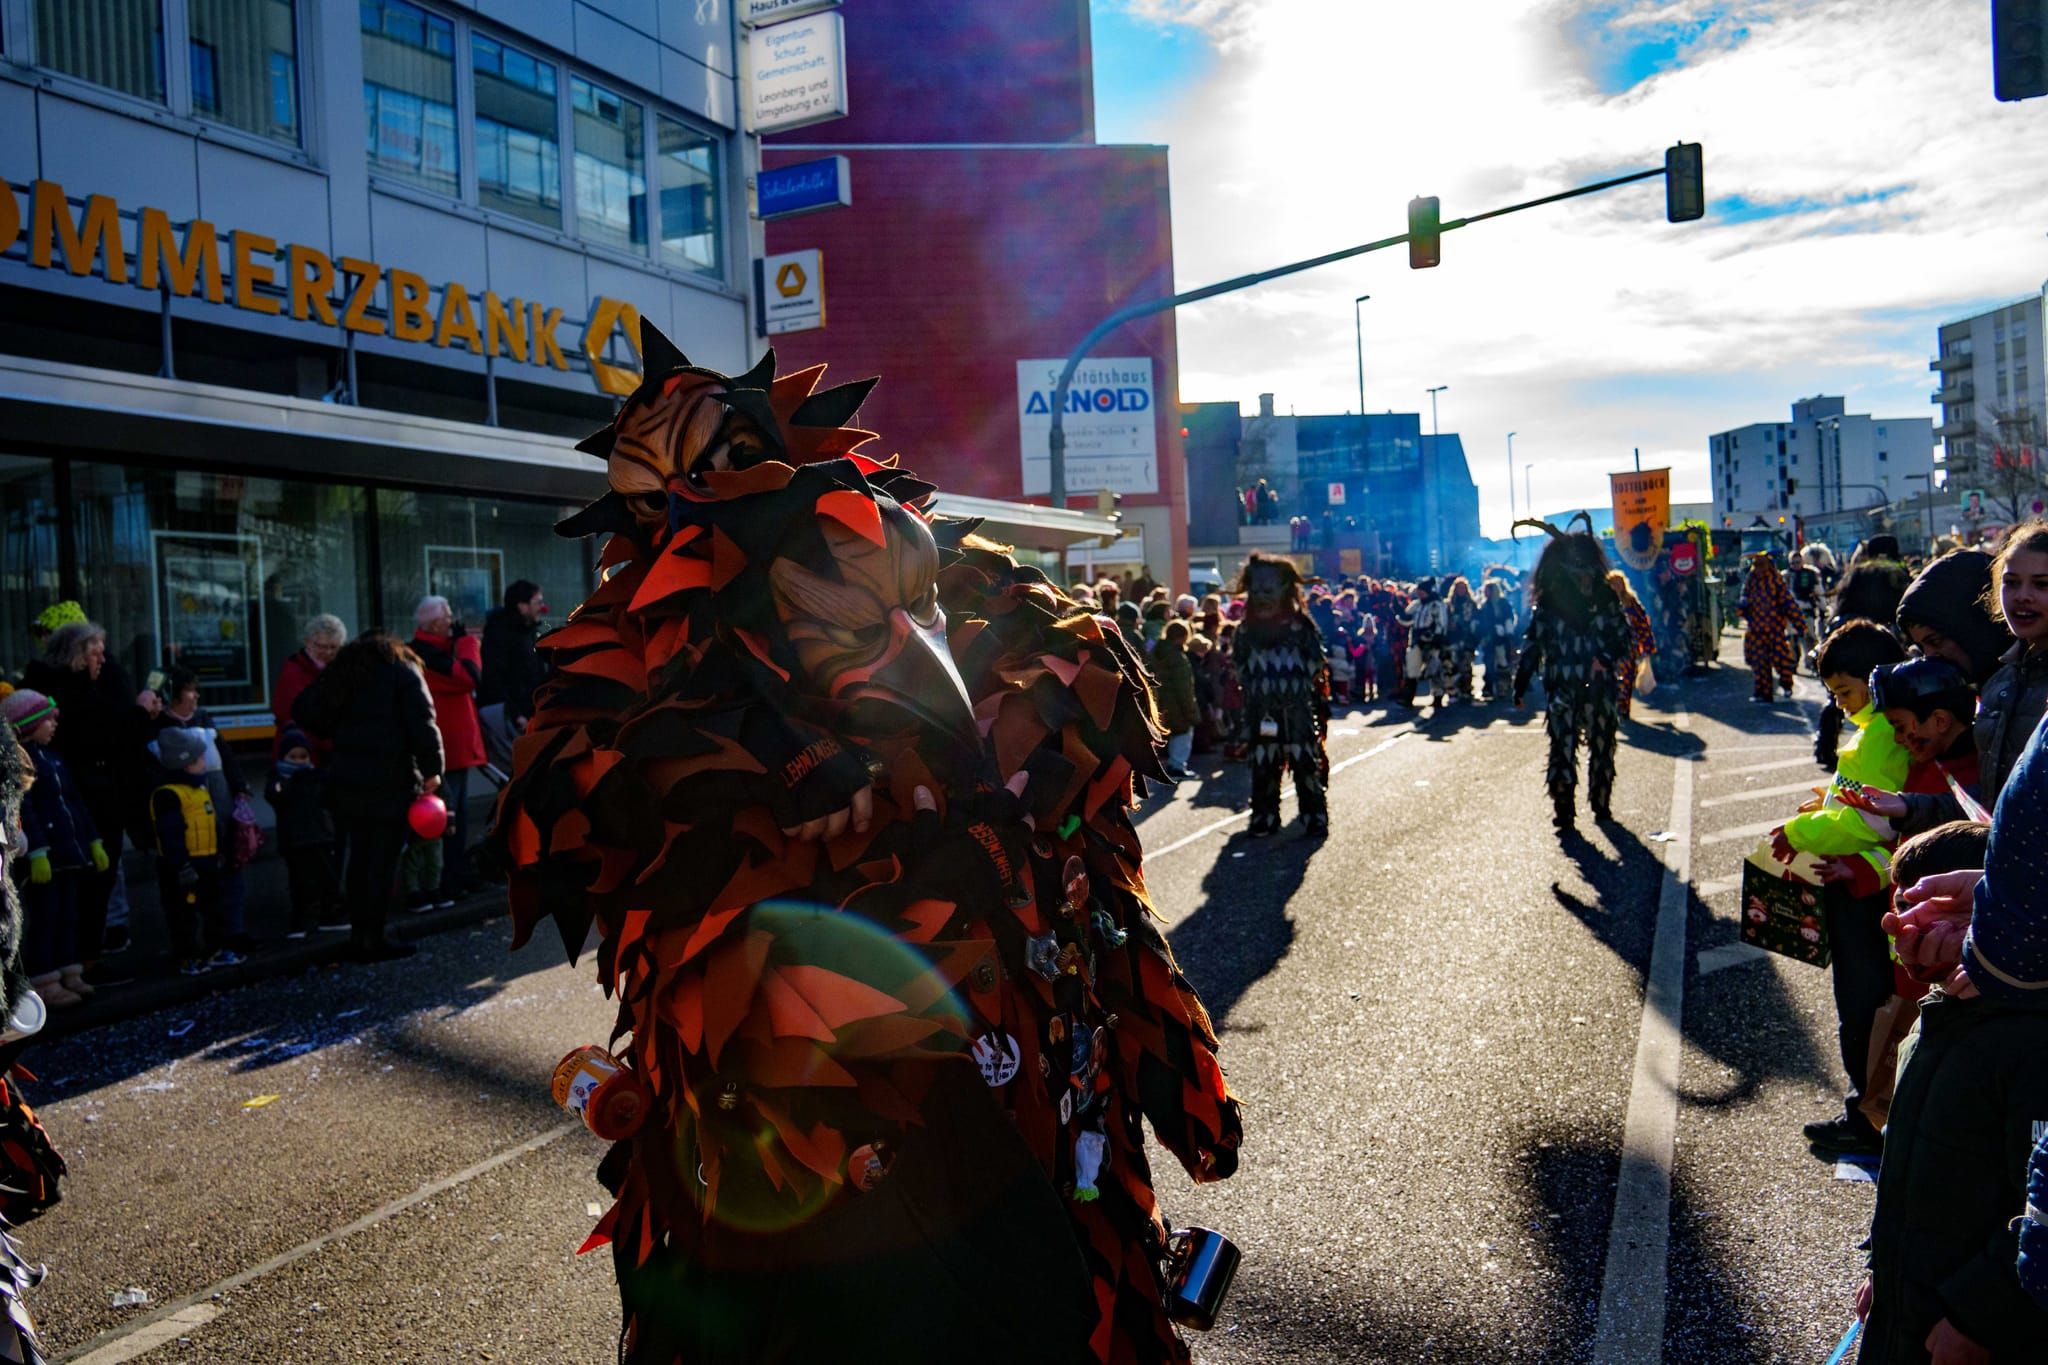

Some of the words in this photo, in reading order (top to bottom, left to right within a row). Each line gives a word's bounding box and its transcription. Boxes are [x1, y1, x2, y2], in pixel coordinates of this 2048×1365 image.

[759, 84, 806, 104] Leonberg
[808, 78, 828, 92] und
[756, 97, 811, 119] Umgebung
